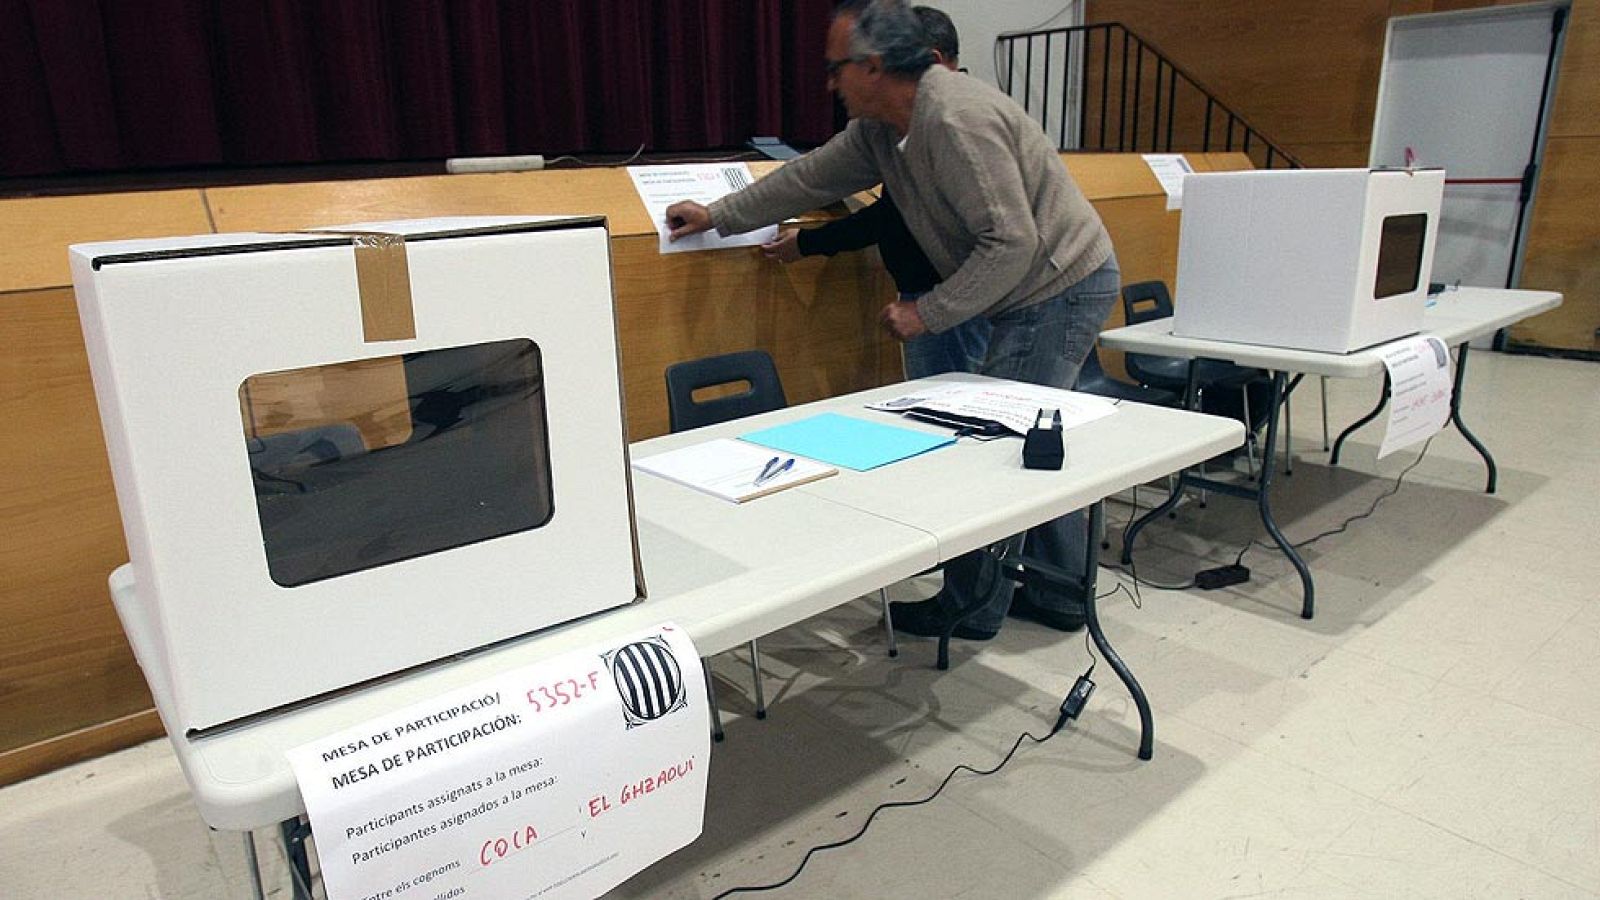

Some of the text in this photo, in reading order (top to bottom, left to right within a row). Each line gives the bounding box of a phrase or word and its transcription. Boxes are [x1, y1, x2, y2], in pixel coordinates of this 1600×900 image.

[322, 740, 369, 762] MESA
[371, 732, 392, 745] DE
[332, 713, 522, 789] MESA DE PARTICIPACIÓN:
[345, 757, 543, 839] Participants assignats a la mesa:
[588, 796, 611, 817] EL
[352, 775, 559, 864] Participantes asignados a la mesa:
[480, 826, 537, 865] COCA
[395, 881, 411, 894] els
[412, 860, 461, 886] cognoms
